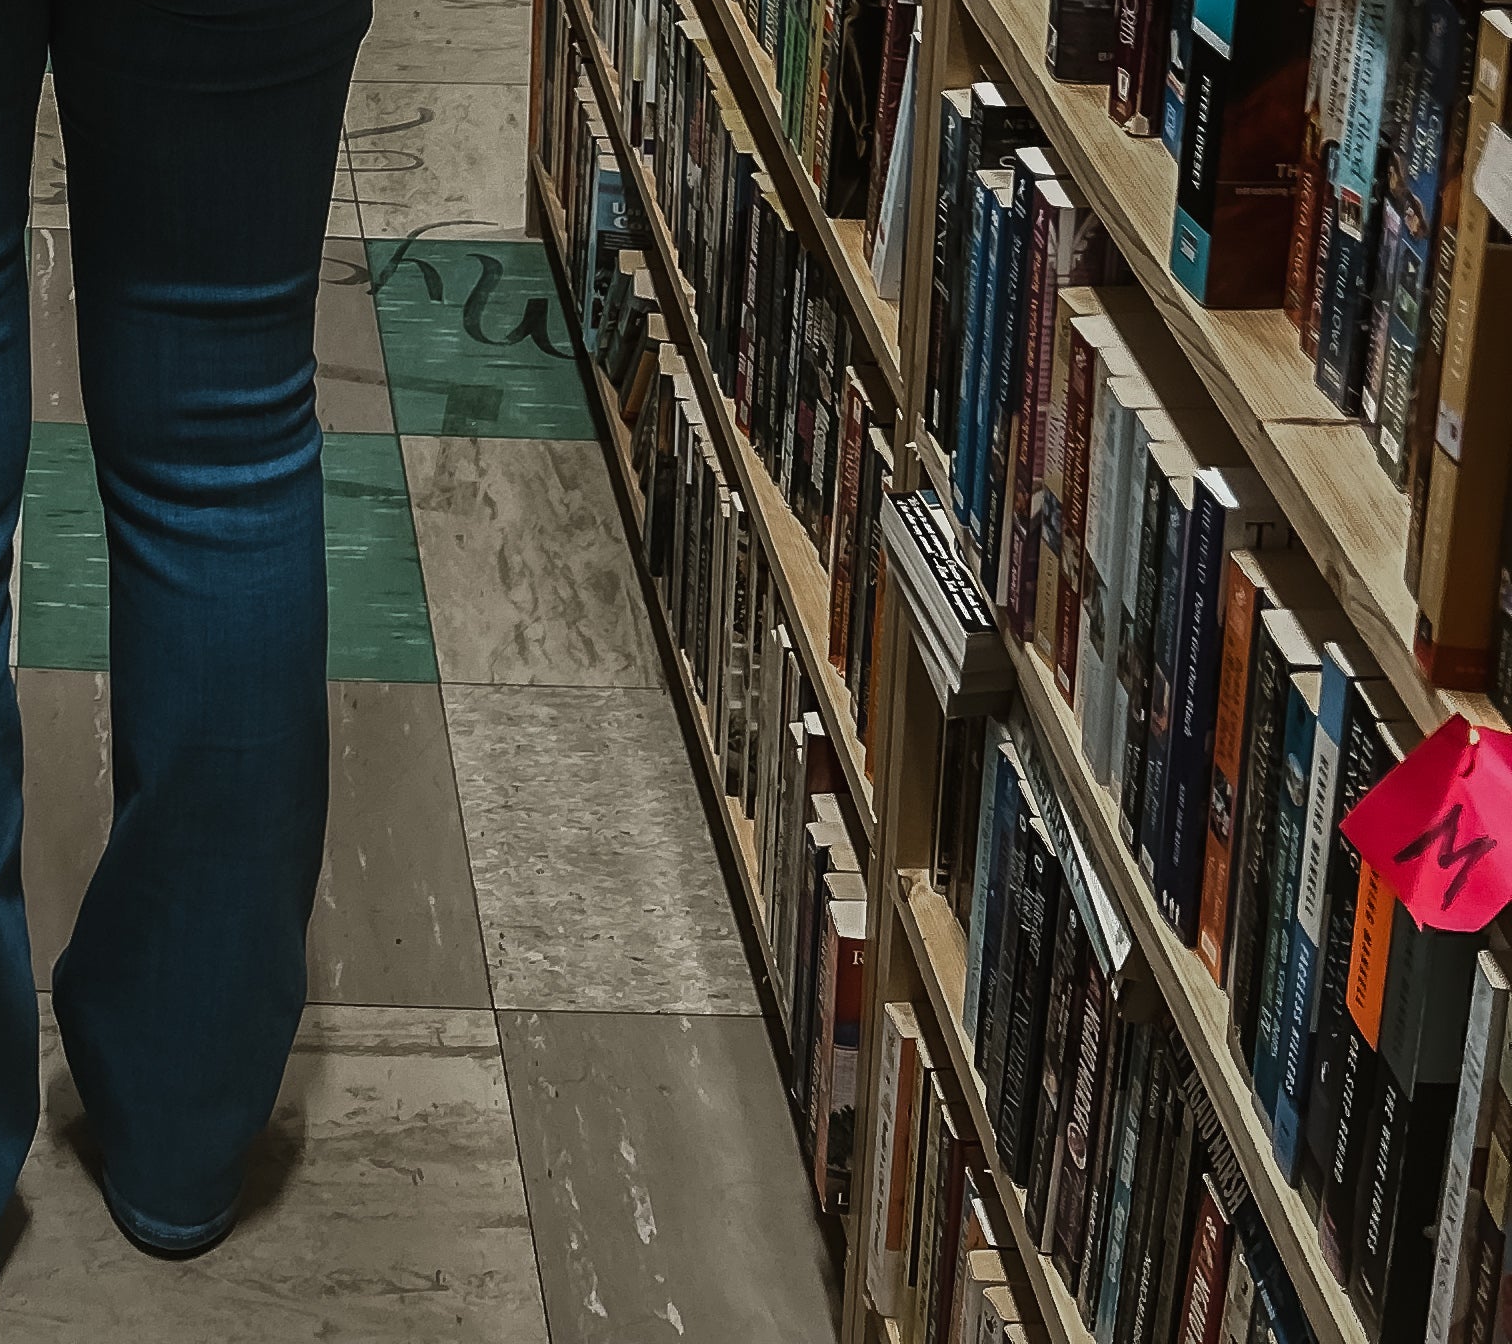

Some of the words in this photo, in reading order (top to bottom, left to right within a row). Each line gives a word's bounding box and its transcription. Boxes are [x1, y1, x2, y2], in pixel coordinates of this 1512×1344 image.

[1197, 75, 1213, 123] PETER
[1190, 127, 1206, 190] LOVESEY
[1391, 804, 1492, 914] M
[1290, 941, 1310, 1023] FACELESS
[1283, 1026, 1301, 1096] KILLERS
